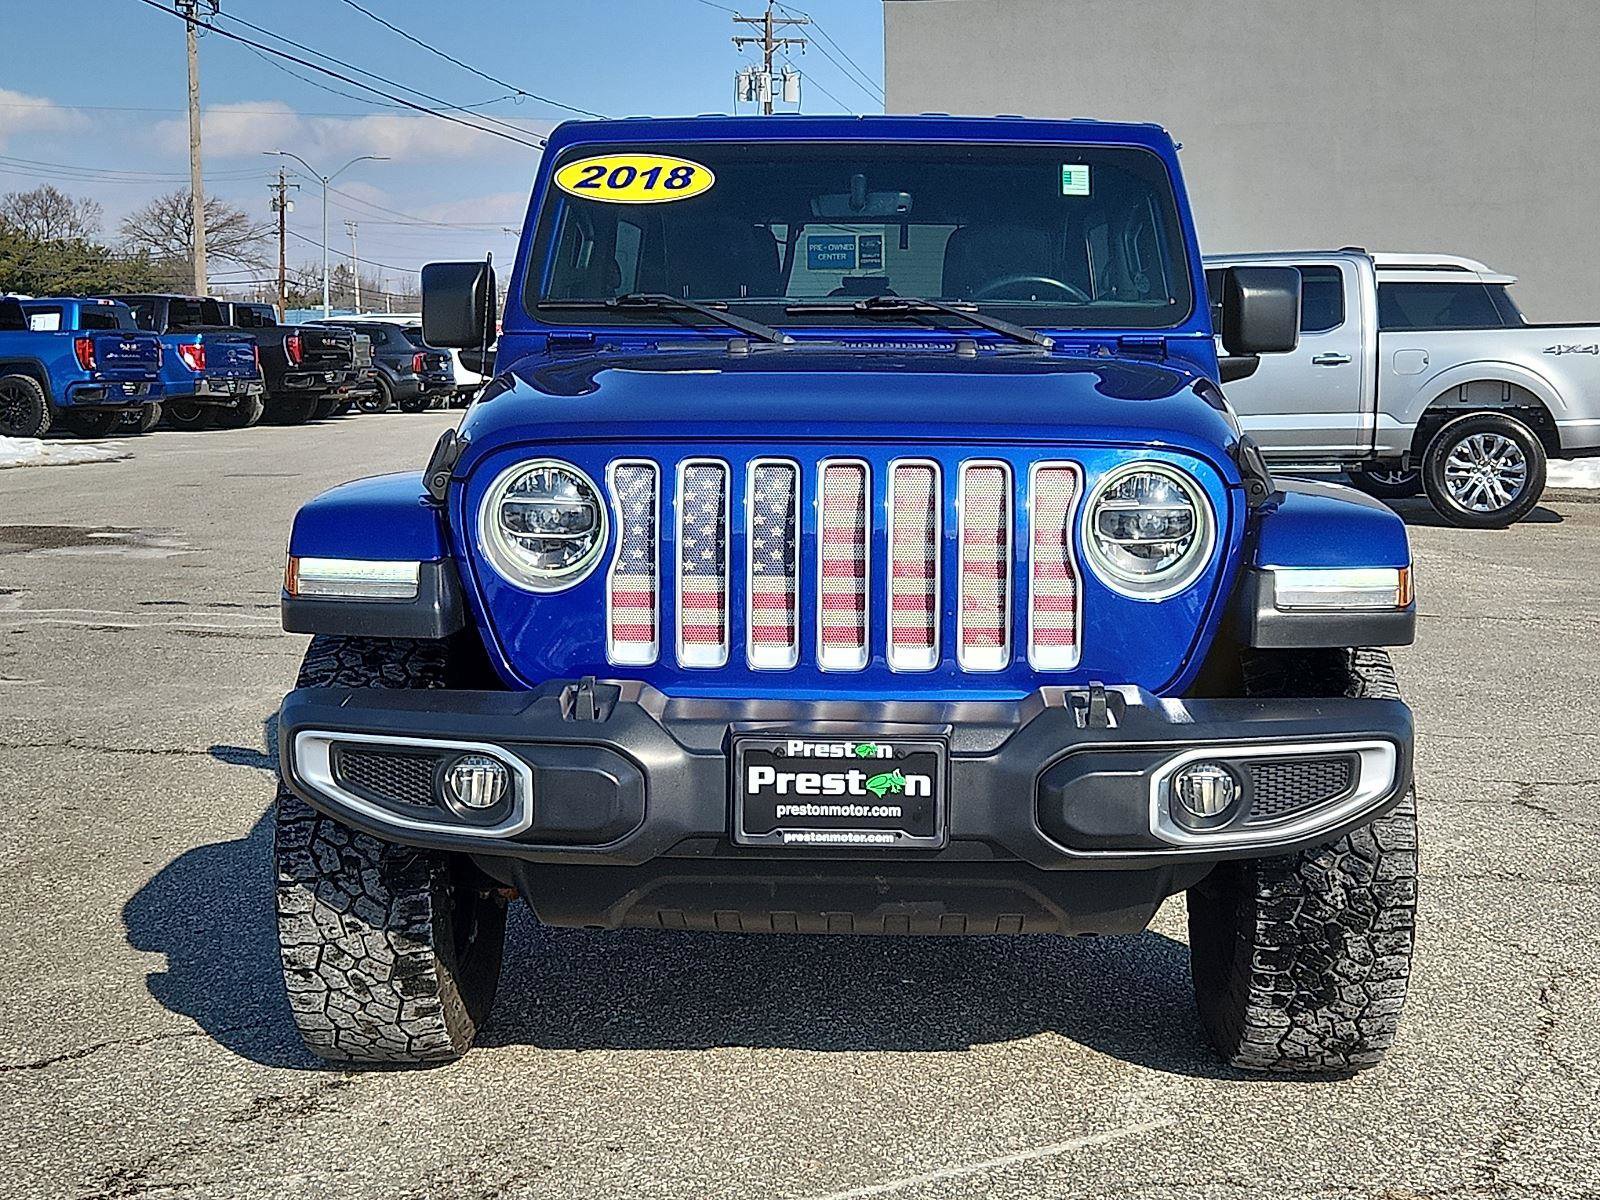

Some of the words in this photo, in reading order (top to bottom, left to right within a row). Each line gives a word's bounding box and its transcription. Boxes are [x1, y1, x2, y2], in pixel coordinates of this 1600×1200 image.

[573, 166, 695, 190] 2018
[818, 253, 847, 261] CENTER
[787, 740, 893, 759] Prestn
[748, 766, 931, 798] Prestn
[777, 804, 902, 818] prestonmotor.com
[784, 832, 895, 844] prestonmotor.com
